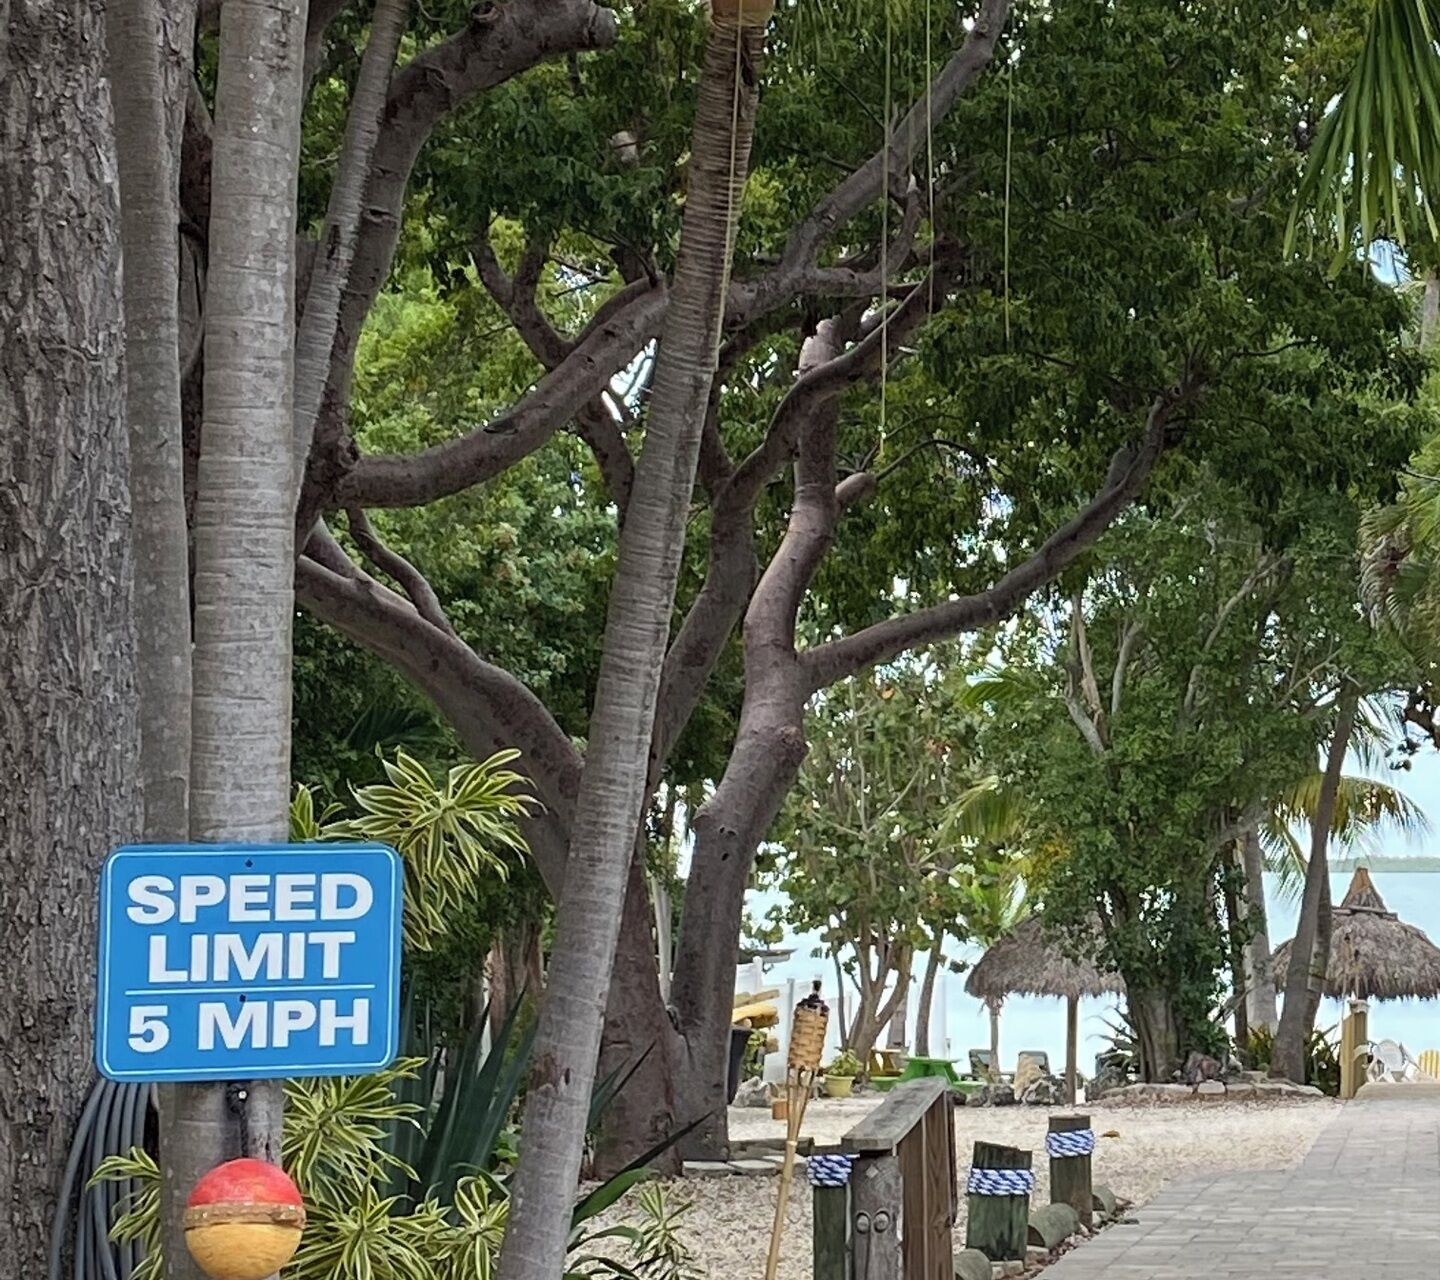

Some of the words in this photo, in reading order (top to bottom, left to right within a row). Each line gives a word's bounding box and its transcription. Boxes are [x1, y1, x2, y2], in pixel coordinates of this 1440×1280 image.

[126, 873, 374, 925] SPEED
[148, 931, 356, 983] LIMIT
[127, 1005, 170, 1053] 5
[197, 998, 370, 1051] MPH
